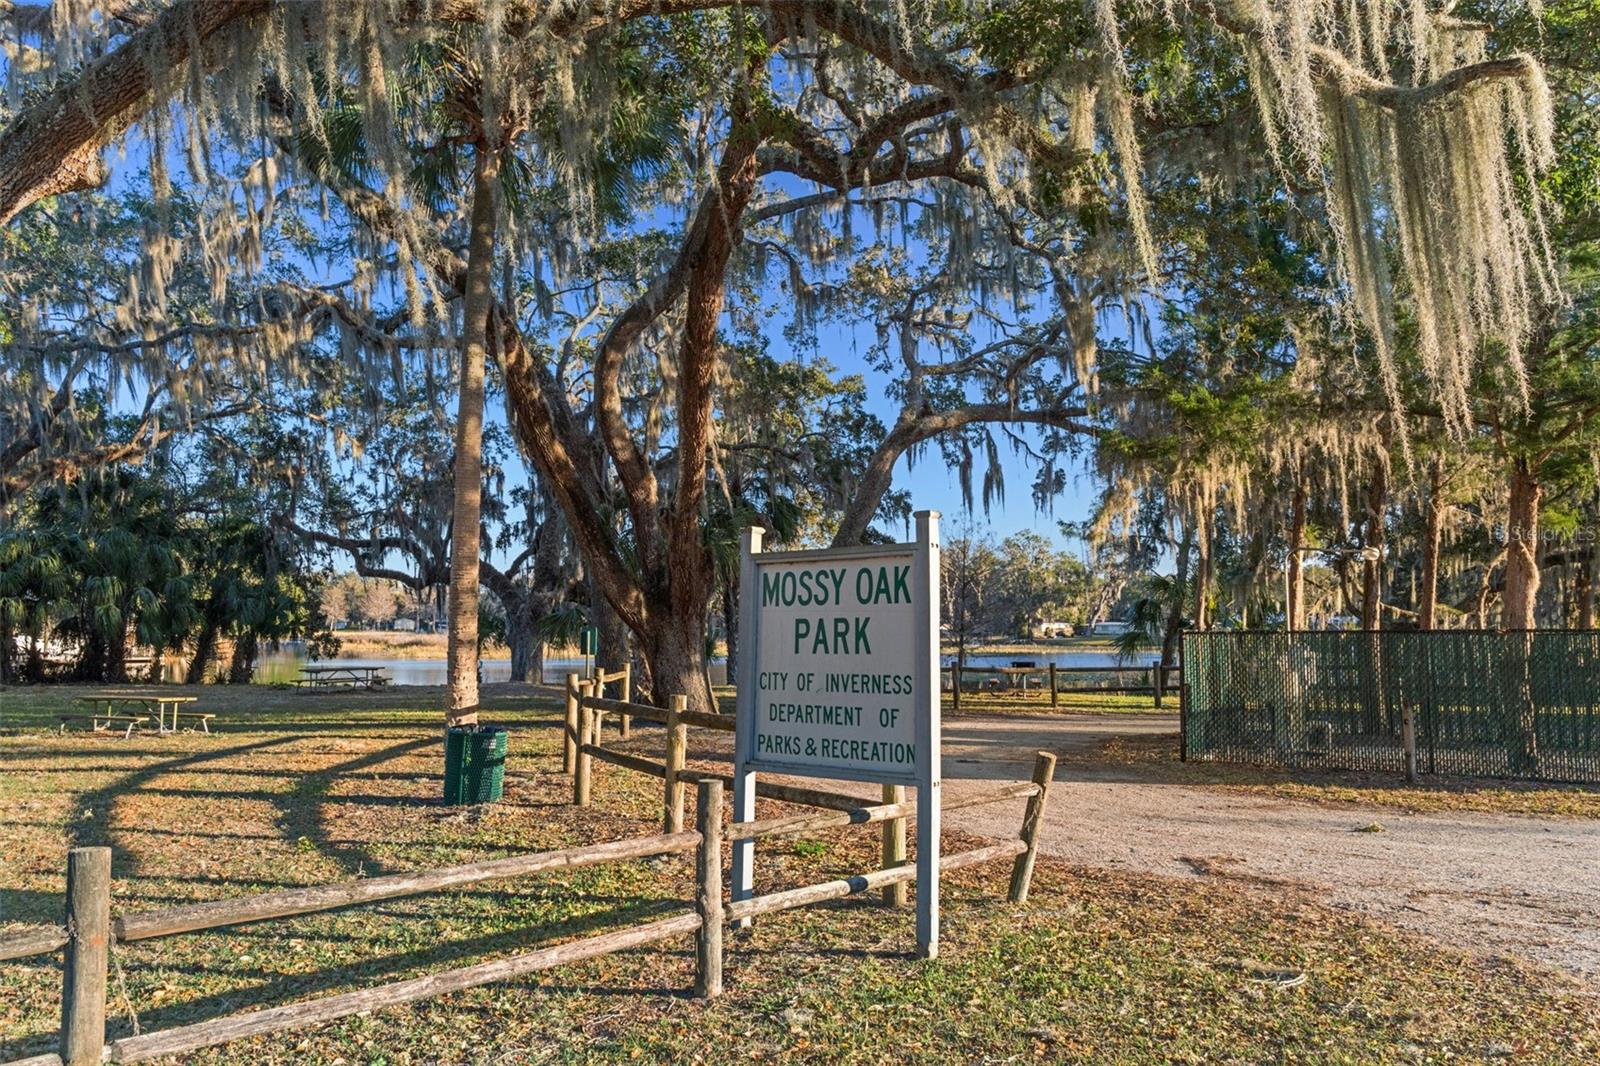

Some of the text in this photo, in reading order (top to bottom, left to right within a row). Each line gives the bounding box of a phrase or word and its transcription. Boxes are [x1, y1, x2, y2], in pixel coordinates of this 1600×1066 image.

[762, 565, 912, 607] MOSSY OAK
[794, 617, 871, 654] PARK
[759, 672, 913, 695] CITY OF INVERNESS
[769, 703, 900, 728] DEPARTMENT OF
[757, 734, 916, 764] PARKS & RECREATION
